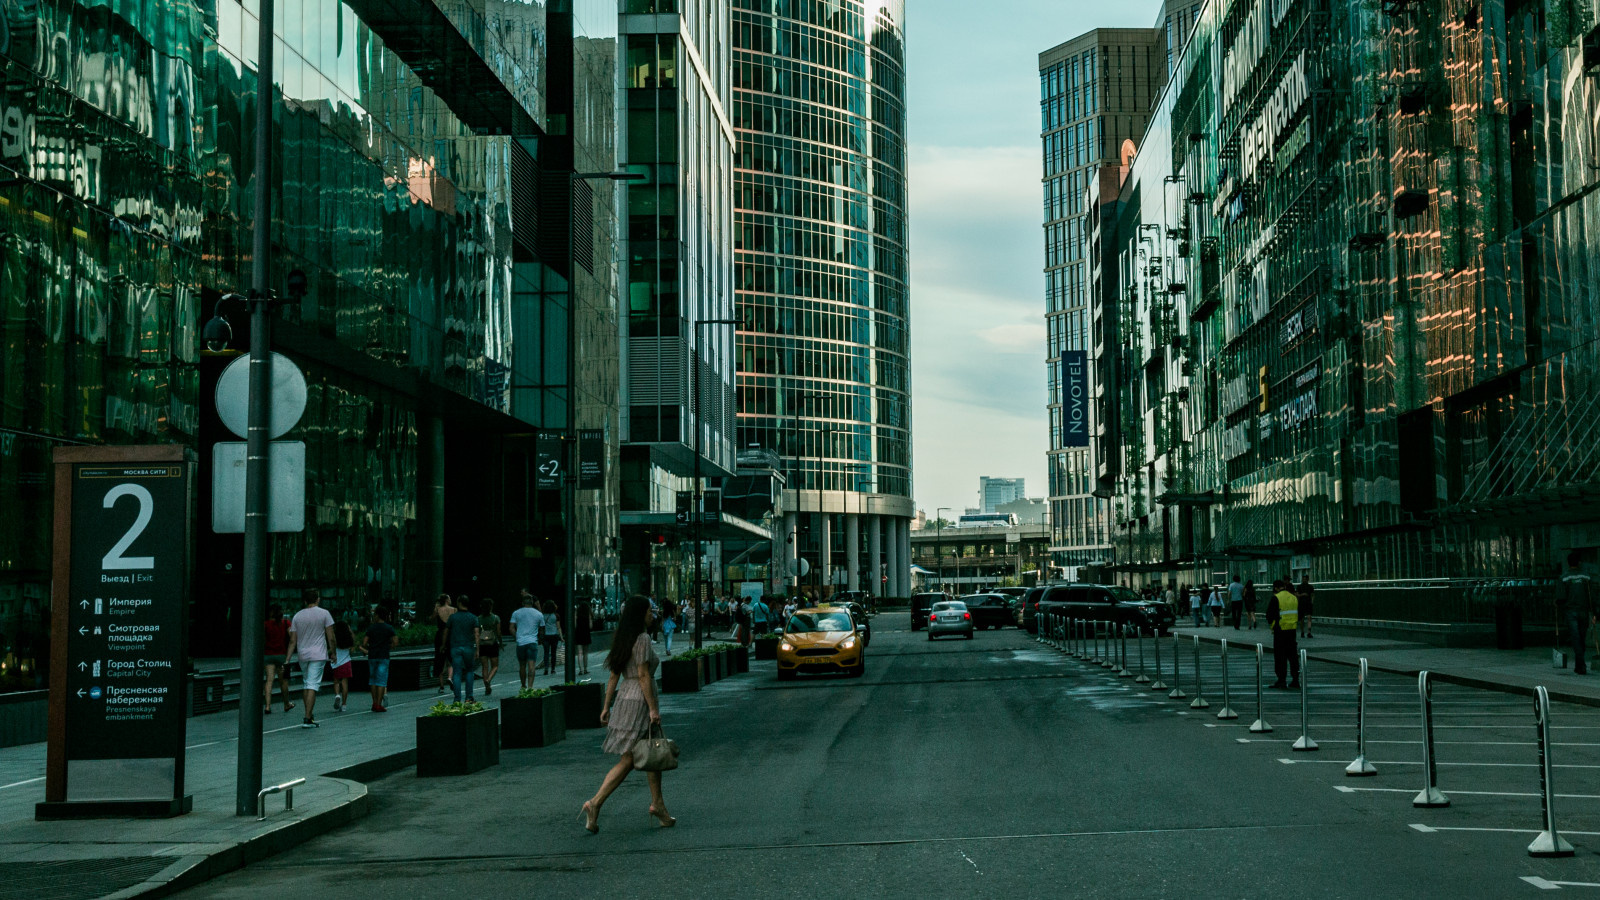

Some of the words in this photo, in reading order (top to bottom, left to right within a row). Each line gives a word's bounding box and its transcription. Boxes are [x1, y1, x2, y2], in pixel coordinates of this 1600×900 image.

[1069, 356, 1083, 433] NOVOTEL
[1280, 389, 1317, 432] ТЕХНОПАРК
[149, 468, 167, 476] СИТИ
[549, 460, 559, 477] 2
[101, 483, 155, 570] 2
[101, 574, 130, 583] Выезд
[137, 574, 153, 582] Exit
[109, 597, 152, 607] Империя
[109, 608, 136, 616] Empire
[108, 624, 160, 634] Смотровая
[108, 633, 153, 642] площадка
[108, 643, 146, 652] Viewpoint
[107, 660, 135, 670] Город
[137, 659, 172, 668] Столиц
[107, 670, 134, 678] Capital
[135, 669, 152, 678] City
[106, 686, 168, 697] Пресненская
[106, 695, 164, 706] набережная
[106, 706, 157, 714] Presnenskaya
[105, 713, 154, 721] embankment
